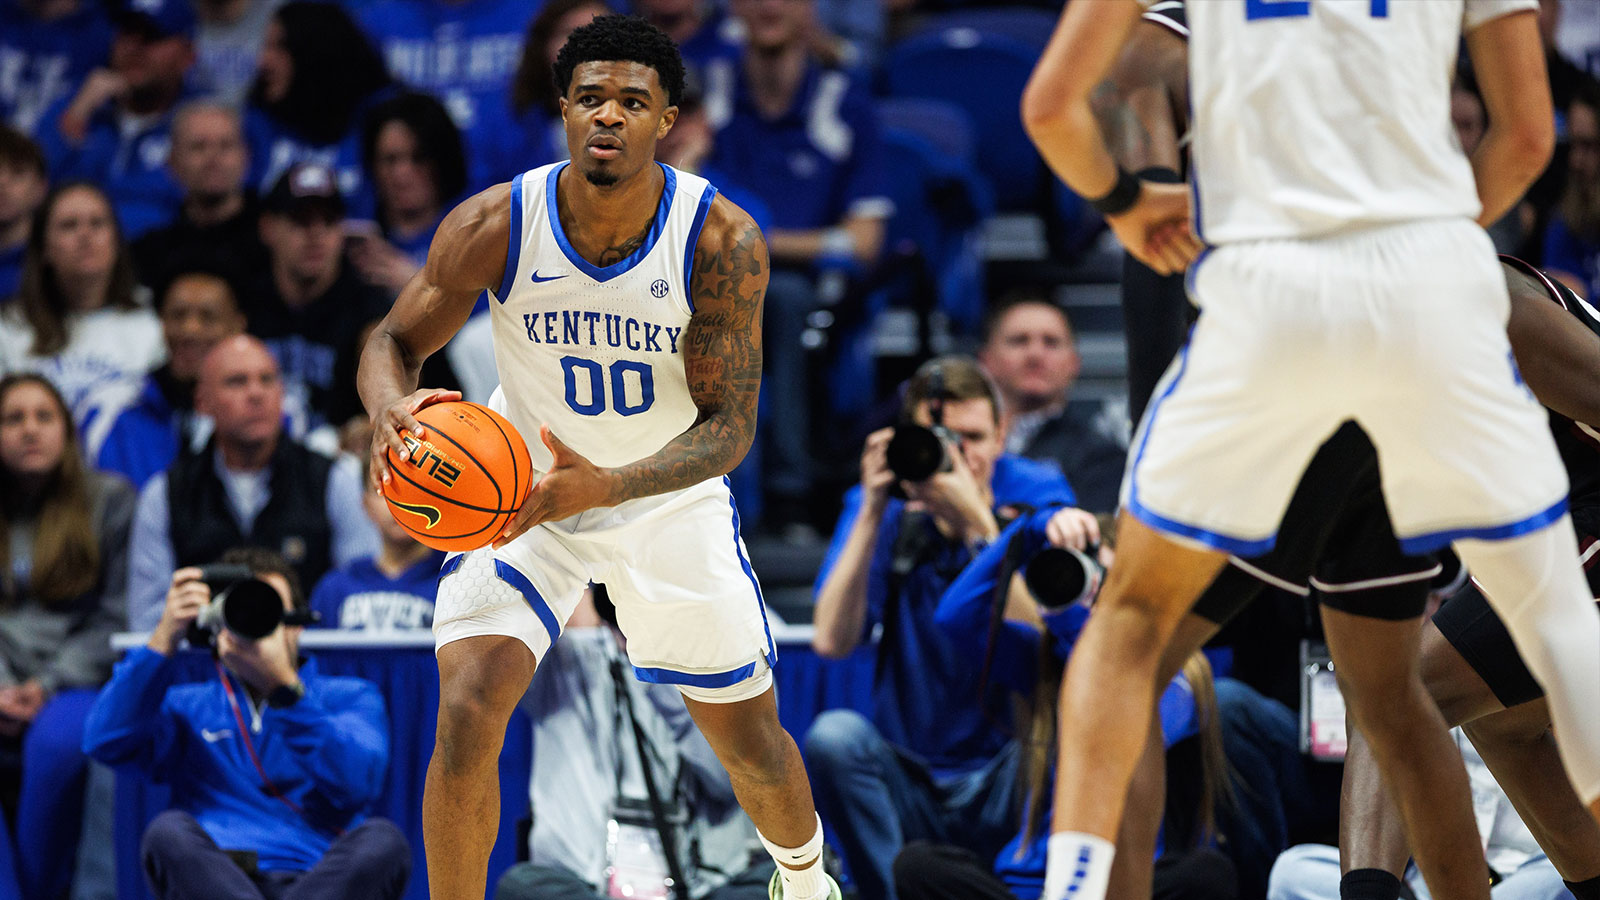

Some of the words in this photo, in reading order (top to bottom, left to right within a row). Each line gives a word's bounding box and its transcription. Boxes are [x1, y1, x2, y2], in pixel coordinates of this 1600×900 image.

[651, 280, 669, 298] SEC
[523, 310, 681, 354] KENTUCKY
[695, 327, 712, 356] by
[687, 356, 722, 380] Faith
[560, 355, 655, 417] 00
[712, 380, 727, 398] by
